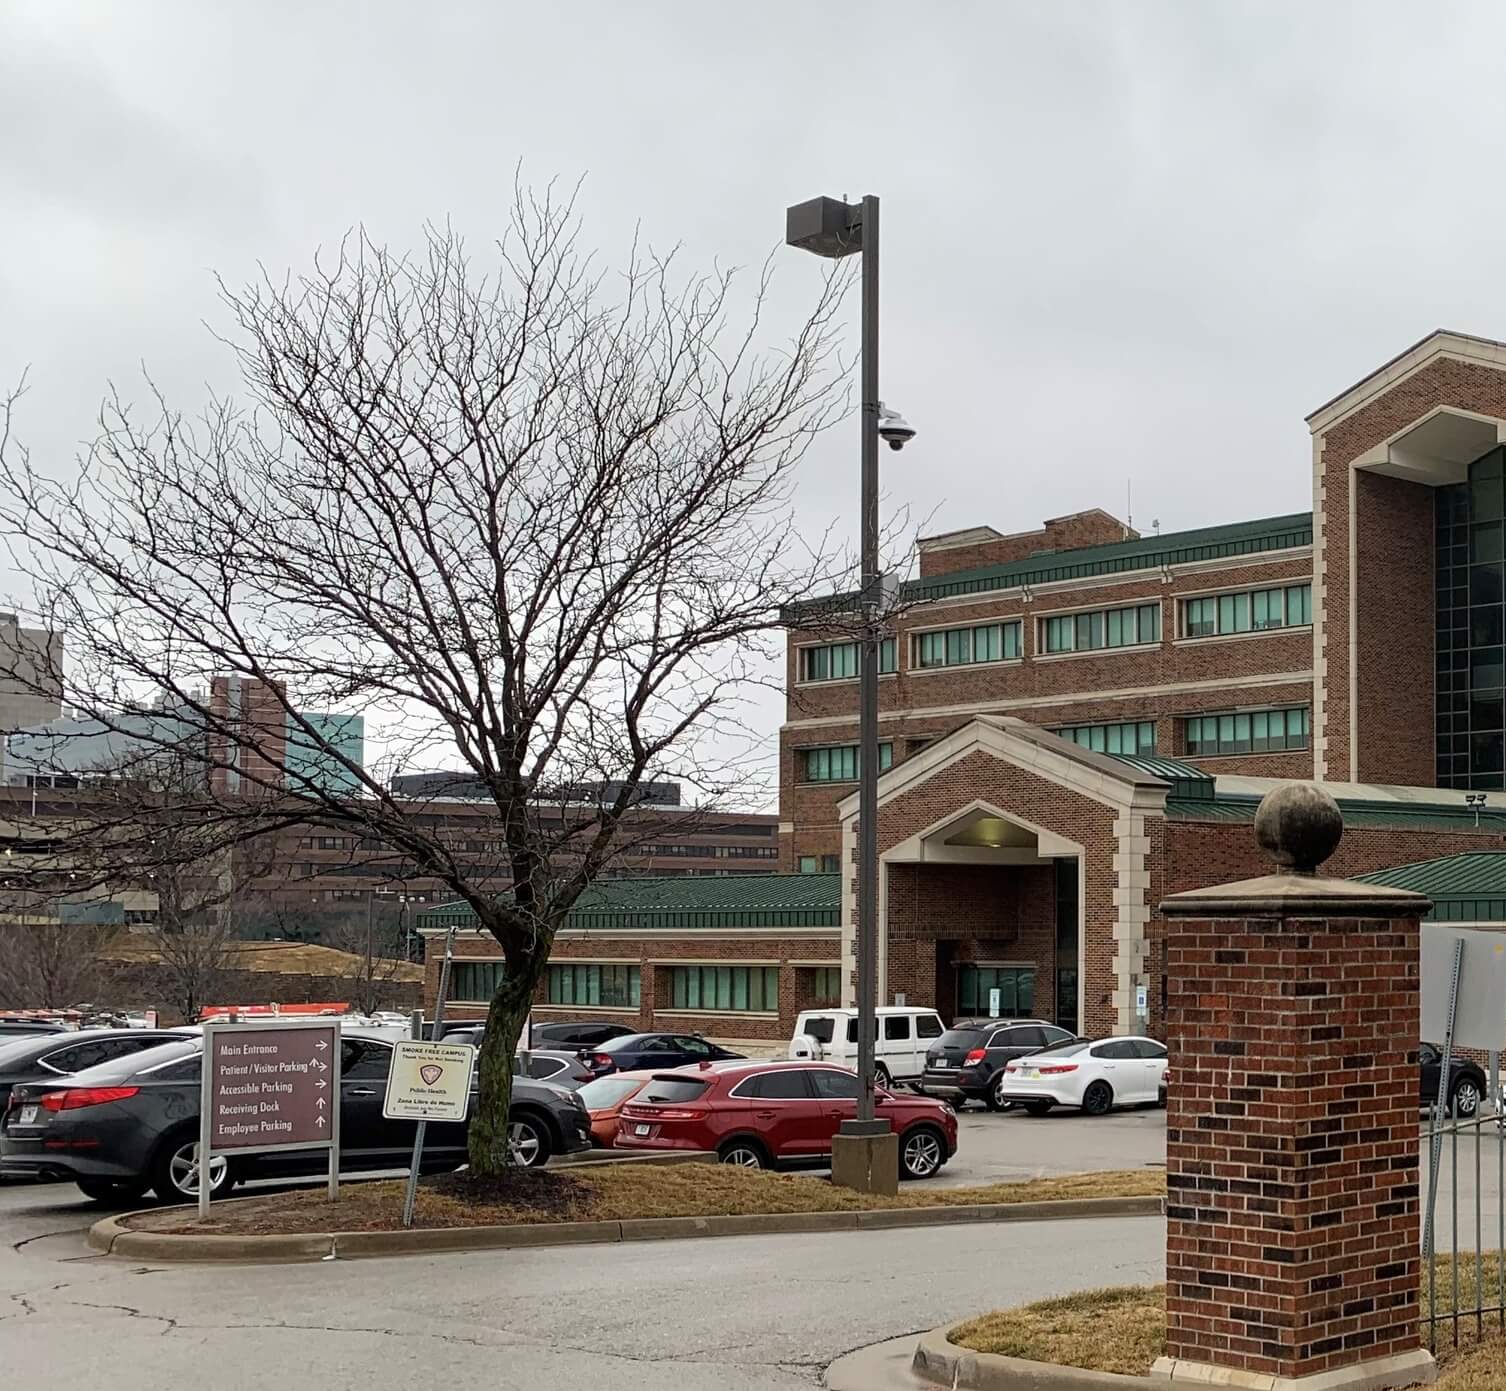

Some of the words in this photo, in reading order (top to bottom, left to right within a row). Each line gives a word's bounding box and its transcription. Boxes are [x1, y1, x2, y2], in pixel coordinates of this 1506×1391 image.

[220, 1045, 241, 1056] Main
[243, 1044, 278, 1055] Entrance
[441, 1049, 466, 1057] CAMPUS
[220, 1065, 248, 1075] Patient
[254, 1063, 278, 1074] Visitor
[279, 1061, 308, 1073] Parking
[220, 1083, 259, 1095] Accessible
[261, 1081, 293, 1093] Parking
[220, 1103, 258, 1115] Receiving
[260, 1100, 280, 1112] Dock
[219, 1122, 259, 1136] Employee
[261, 1120, 292, 1132] Parking
